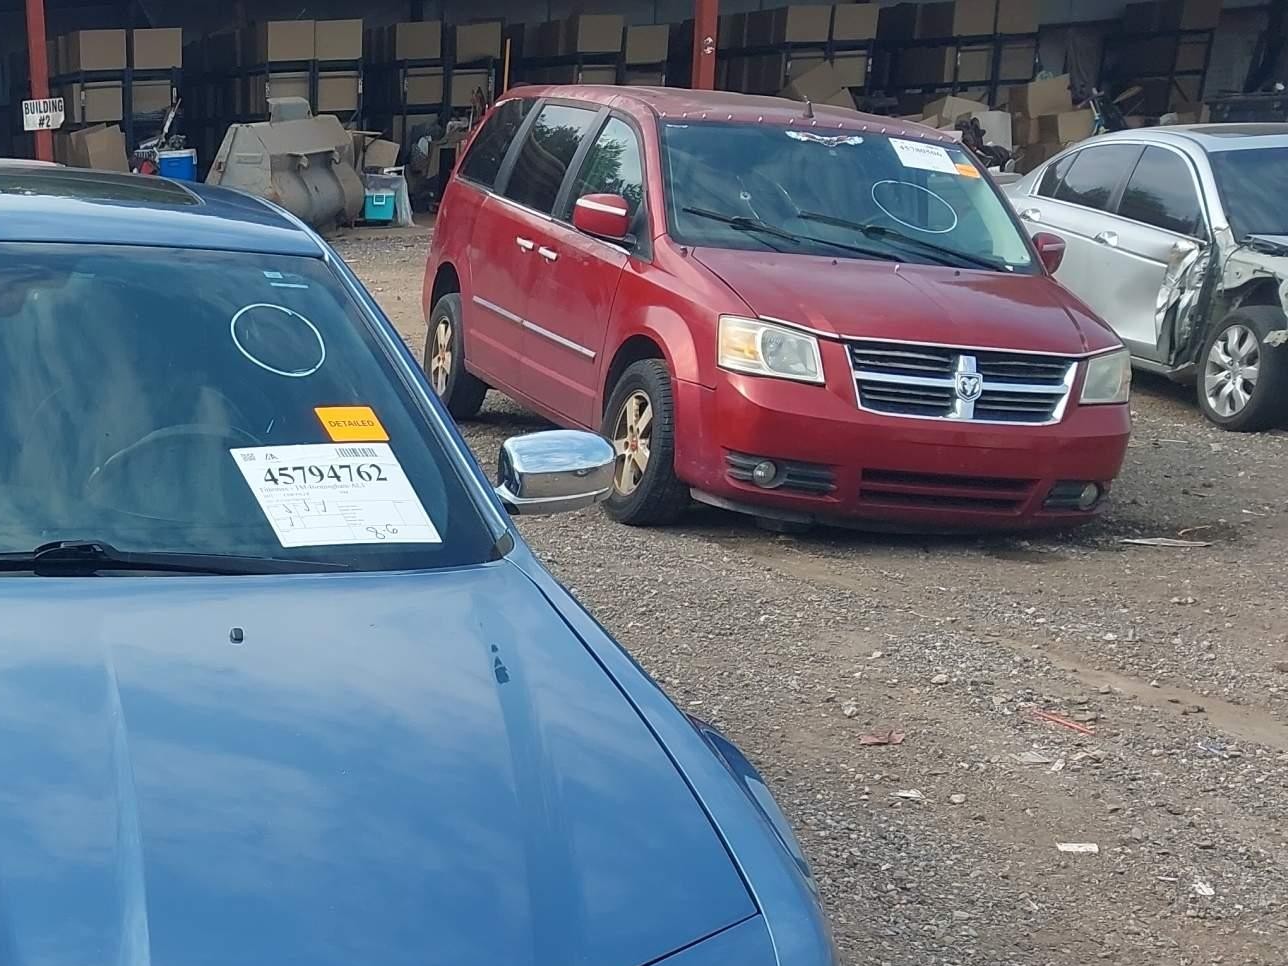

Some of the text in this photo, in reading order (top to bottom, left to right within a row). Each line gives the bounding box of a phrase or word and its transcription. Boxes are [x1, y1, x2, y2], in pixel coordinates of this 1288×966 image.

[23, 99, 64, 115] BUILDING
[38, 115, 51, 128] #2
[327, 419, 375, 428] DETAILED
[263, 463, 388, 486] 45794762
